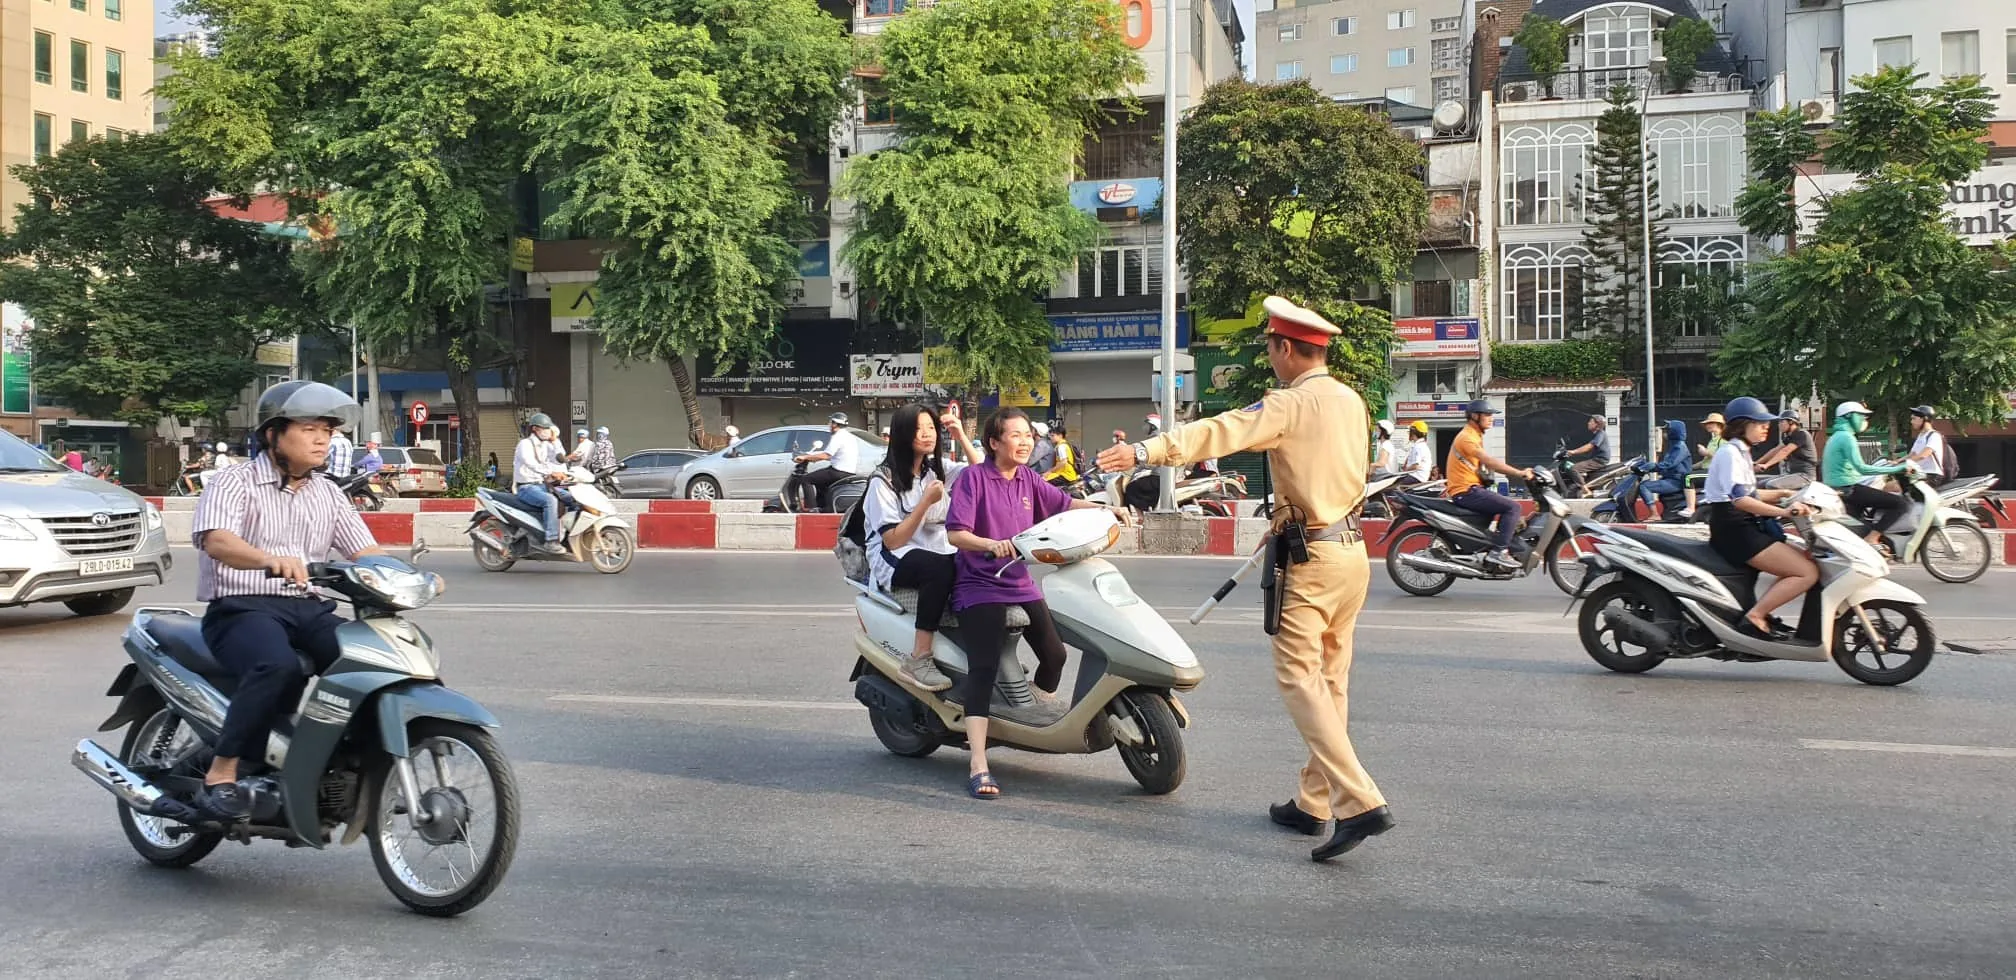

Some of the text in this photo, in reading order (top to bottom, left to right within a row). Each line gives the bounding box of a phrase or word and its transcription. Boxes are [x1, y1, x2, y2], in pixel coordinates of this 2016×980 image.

[1949, 183, 2016, 209] ang
[1102, 321, 1139, 338] HÀM
[774, 360, 796, 369] CHIC
